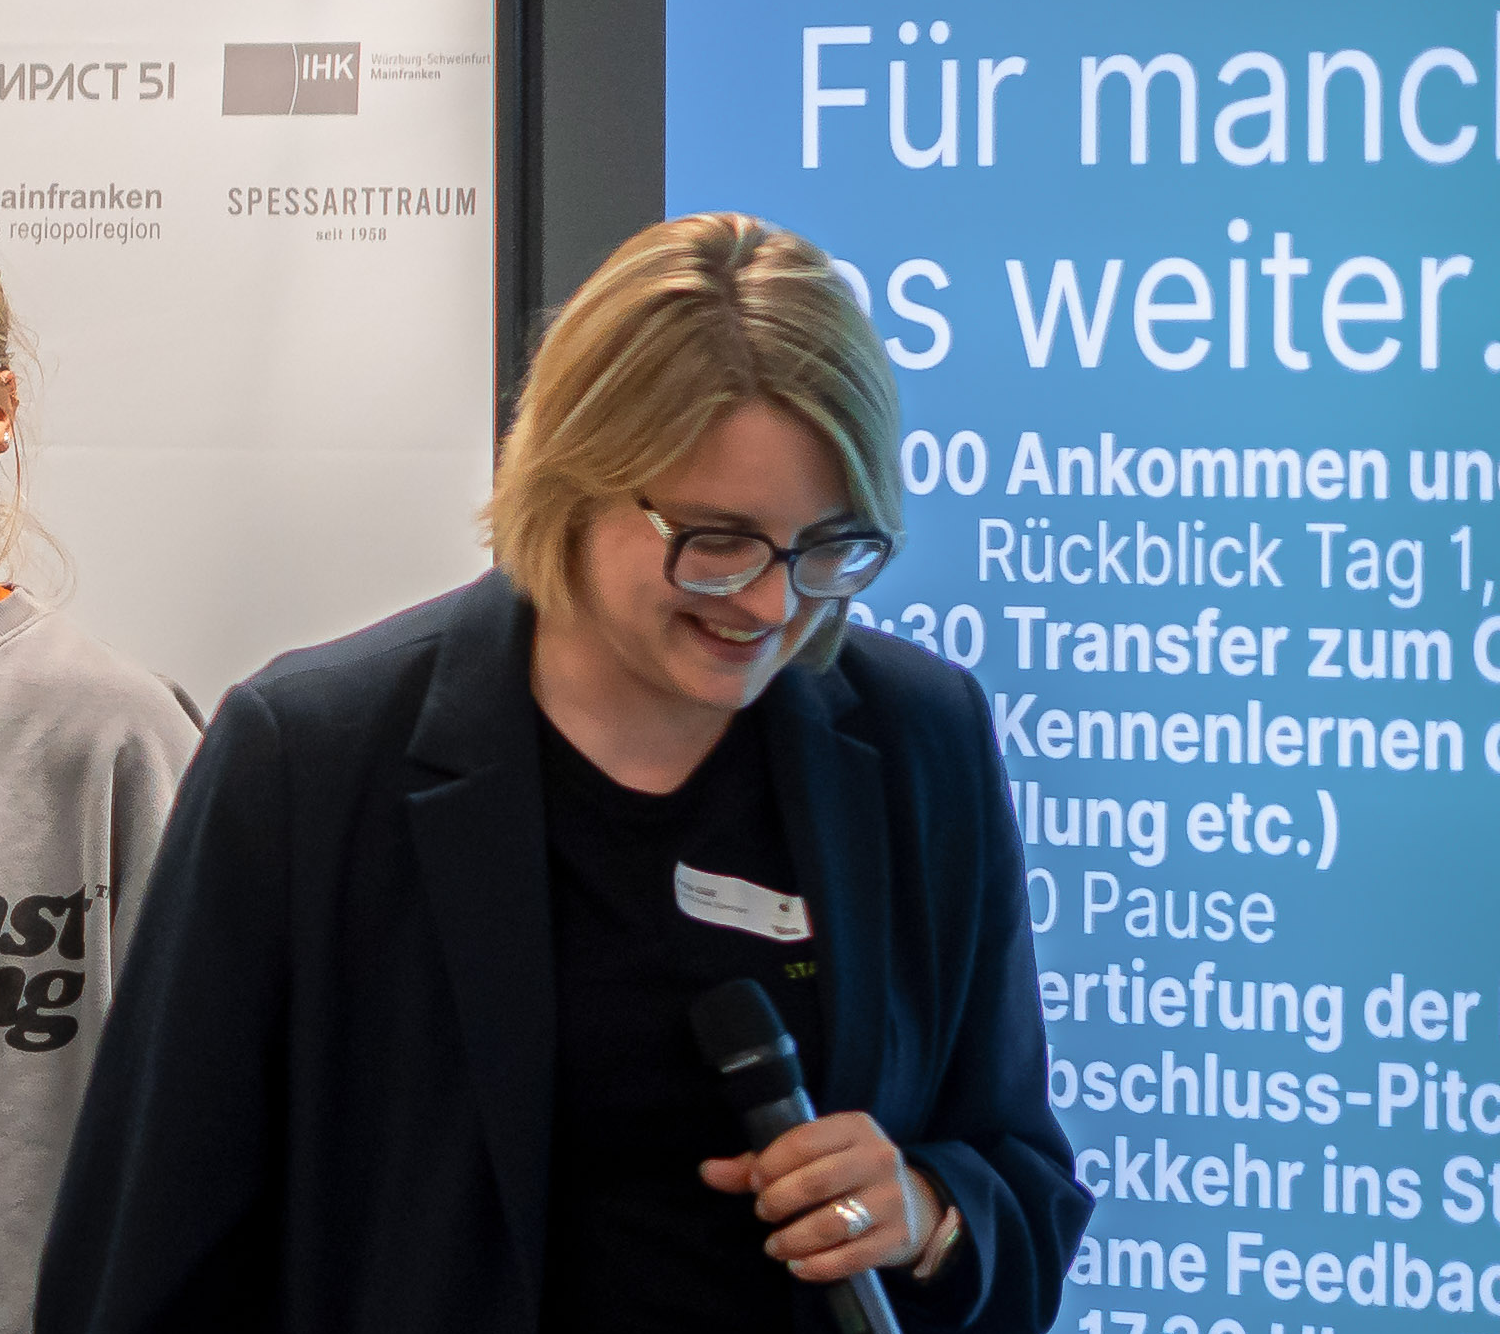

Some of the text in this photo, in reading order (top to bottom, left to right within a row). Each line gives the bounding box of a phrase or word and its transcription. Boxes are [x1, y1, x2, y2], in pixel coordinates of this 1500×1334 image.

[301, 53, 355, 81] IHK
[802, 20, 1028, 169] Für
[10, 217, 162, 246] regiopolregion
[227, 186, 477, 217] SPESSARTTRAUM
[315, 226, 343, 242] seit
[1005, 218, 1500, 372] weiter.
[1005, 430, 1390, 501] Ankommen
[1409, 449, 1500, 502] un
[978, 515, 1495, 608] Rückblick Tag 1,
[1003, 604, 1289, 678] Transfer
[1306, 627, 1453, 681] zum
[994, 691, 1465, 772] Kennenlernen
[1185, 788, 1340, 870] etc.)
[1082, 869, 1277, 944] Pause
[1040, 958, 1481, 1051] ertiefung der
[1322, 1144, 1422, 1221] ins
